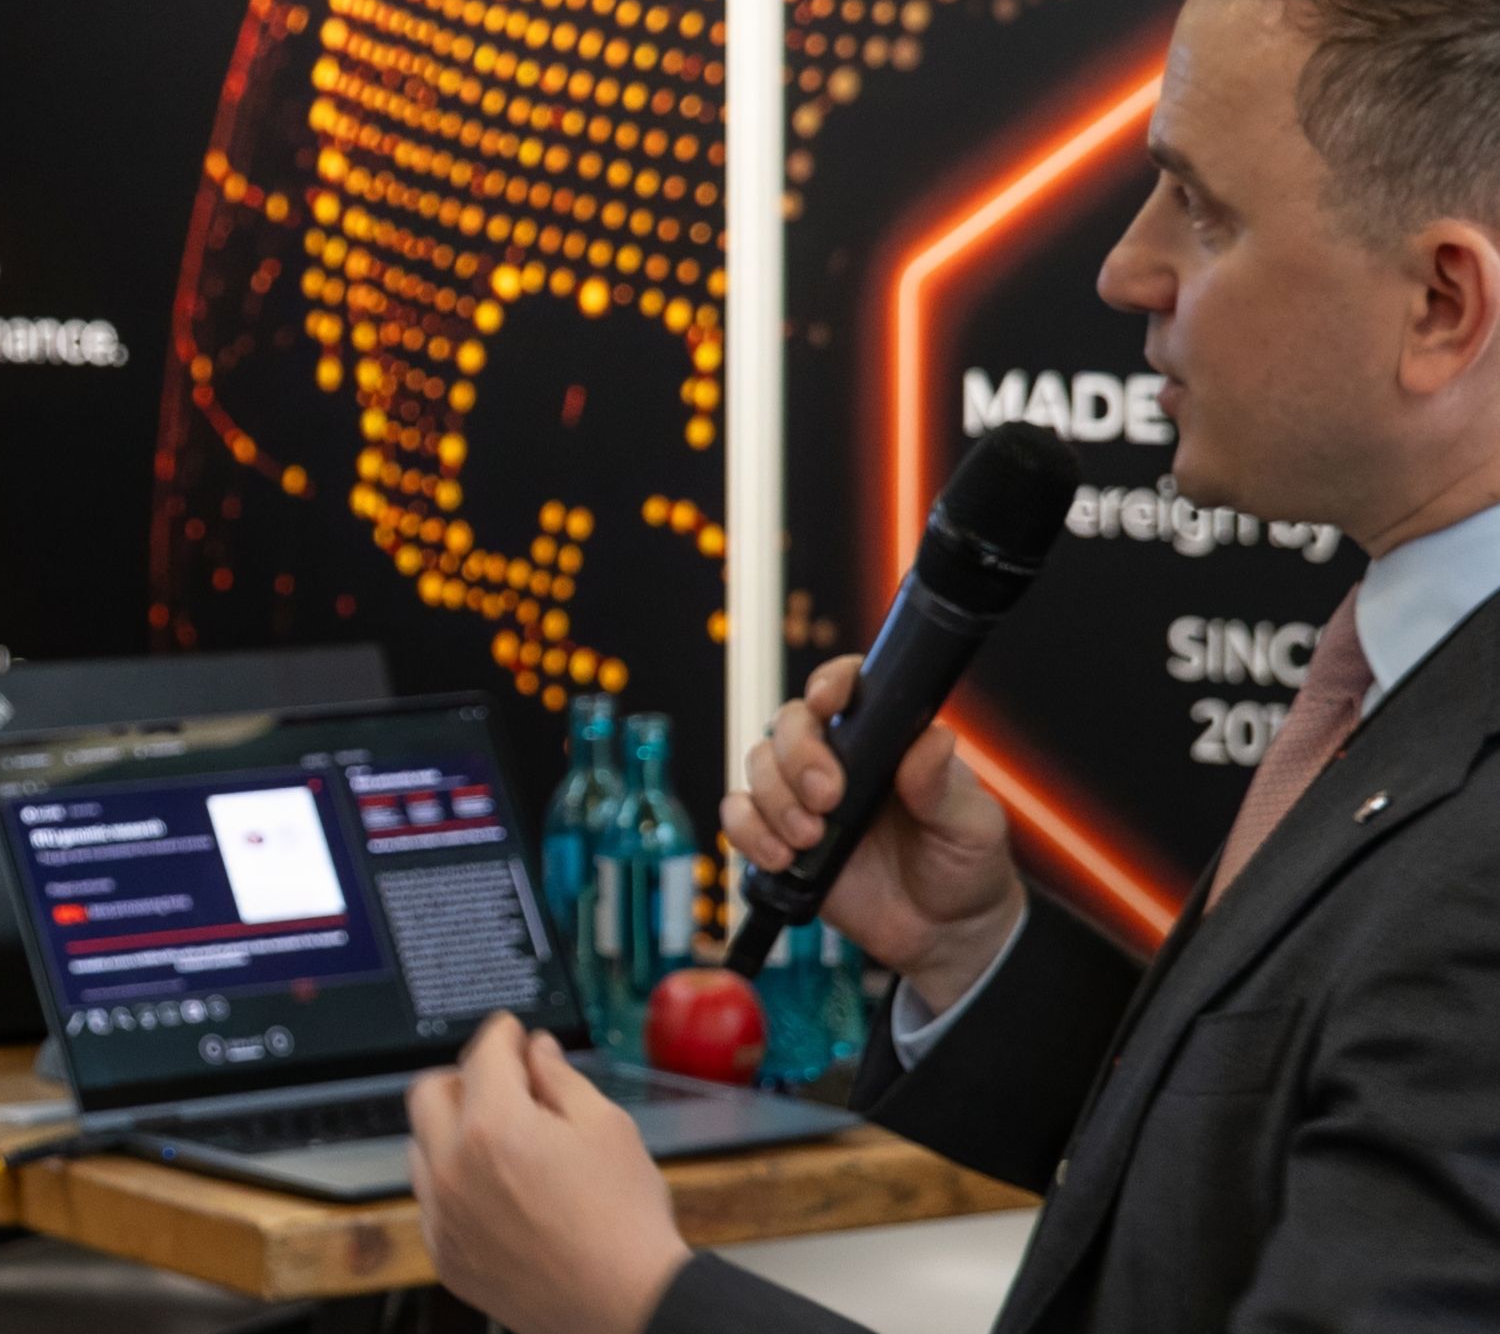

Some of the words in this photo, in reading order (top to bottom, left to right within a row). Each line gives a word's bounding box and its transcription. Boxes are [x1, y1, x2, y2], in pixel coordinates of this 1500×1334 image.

[962, 367, 1176, 445] MADE
[1065, 473, 1260, 557] ereign
[1166, 615, 1325, 689] SINC
